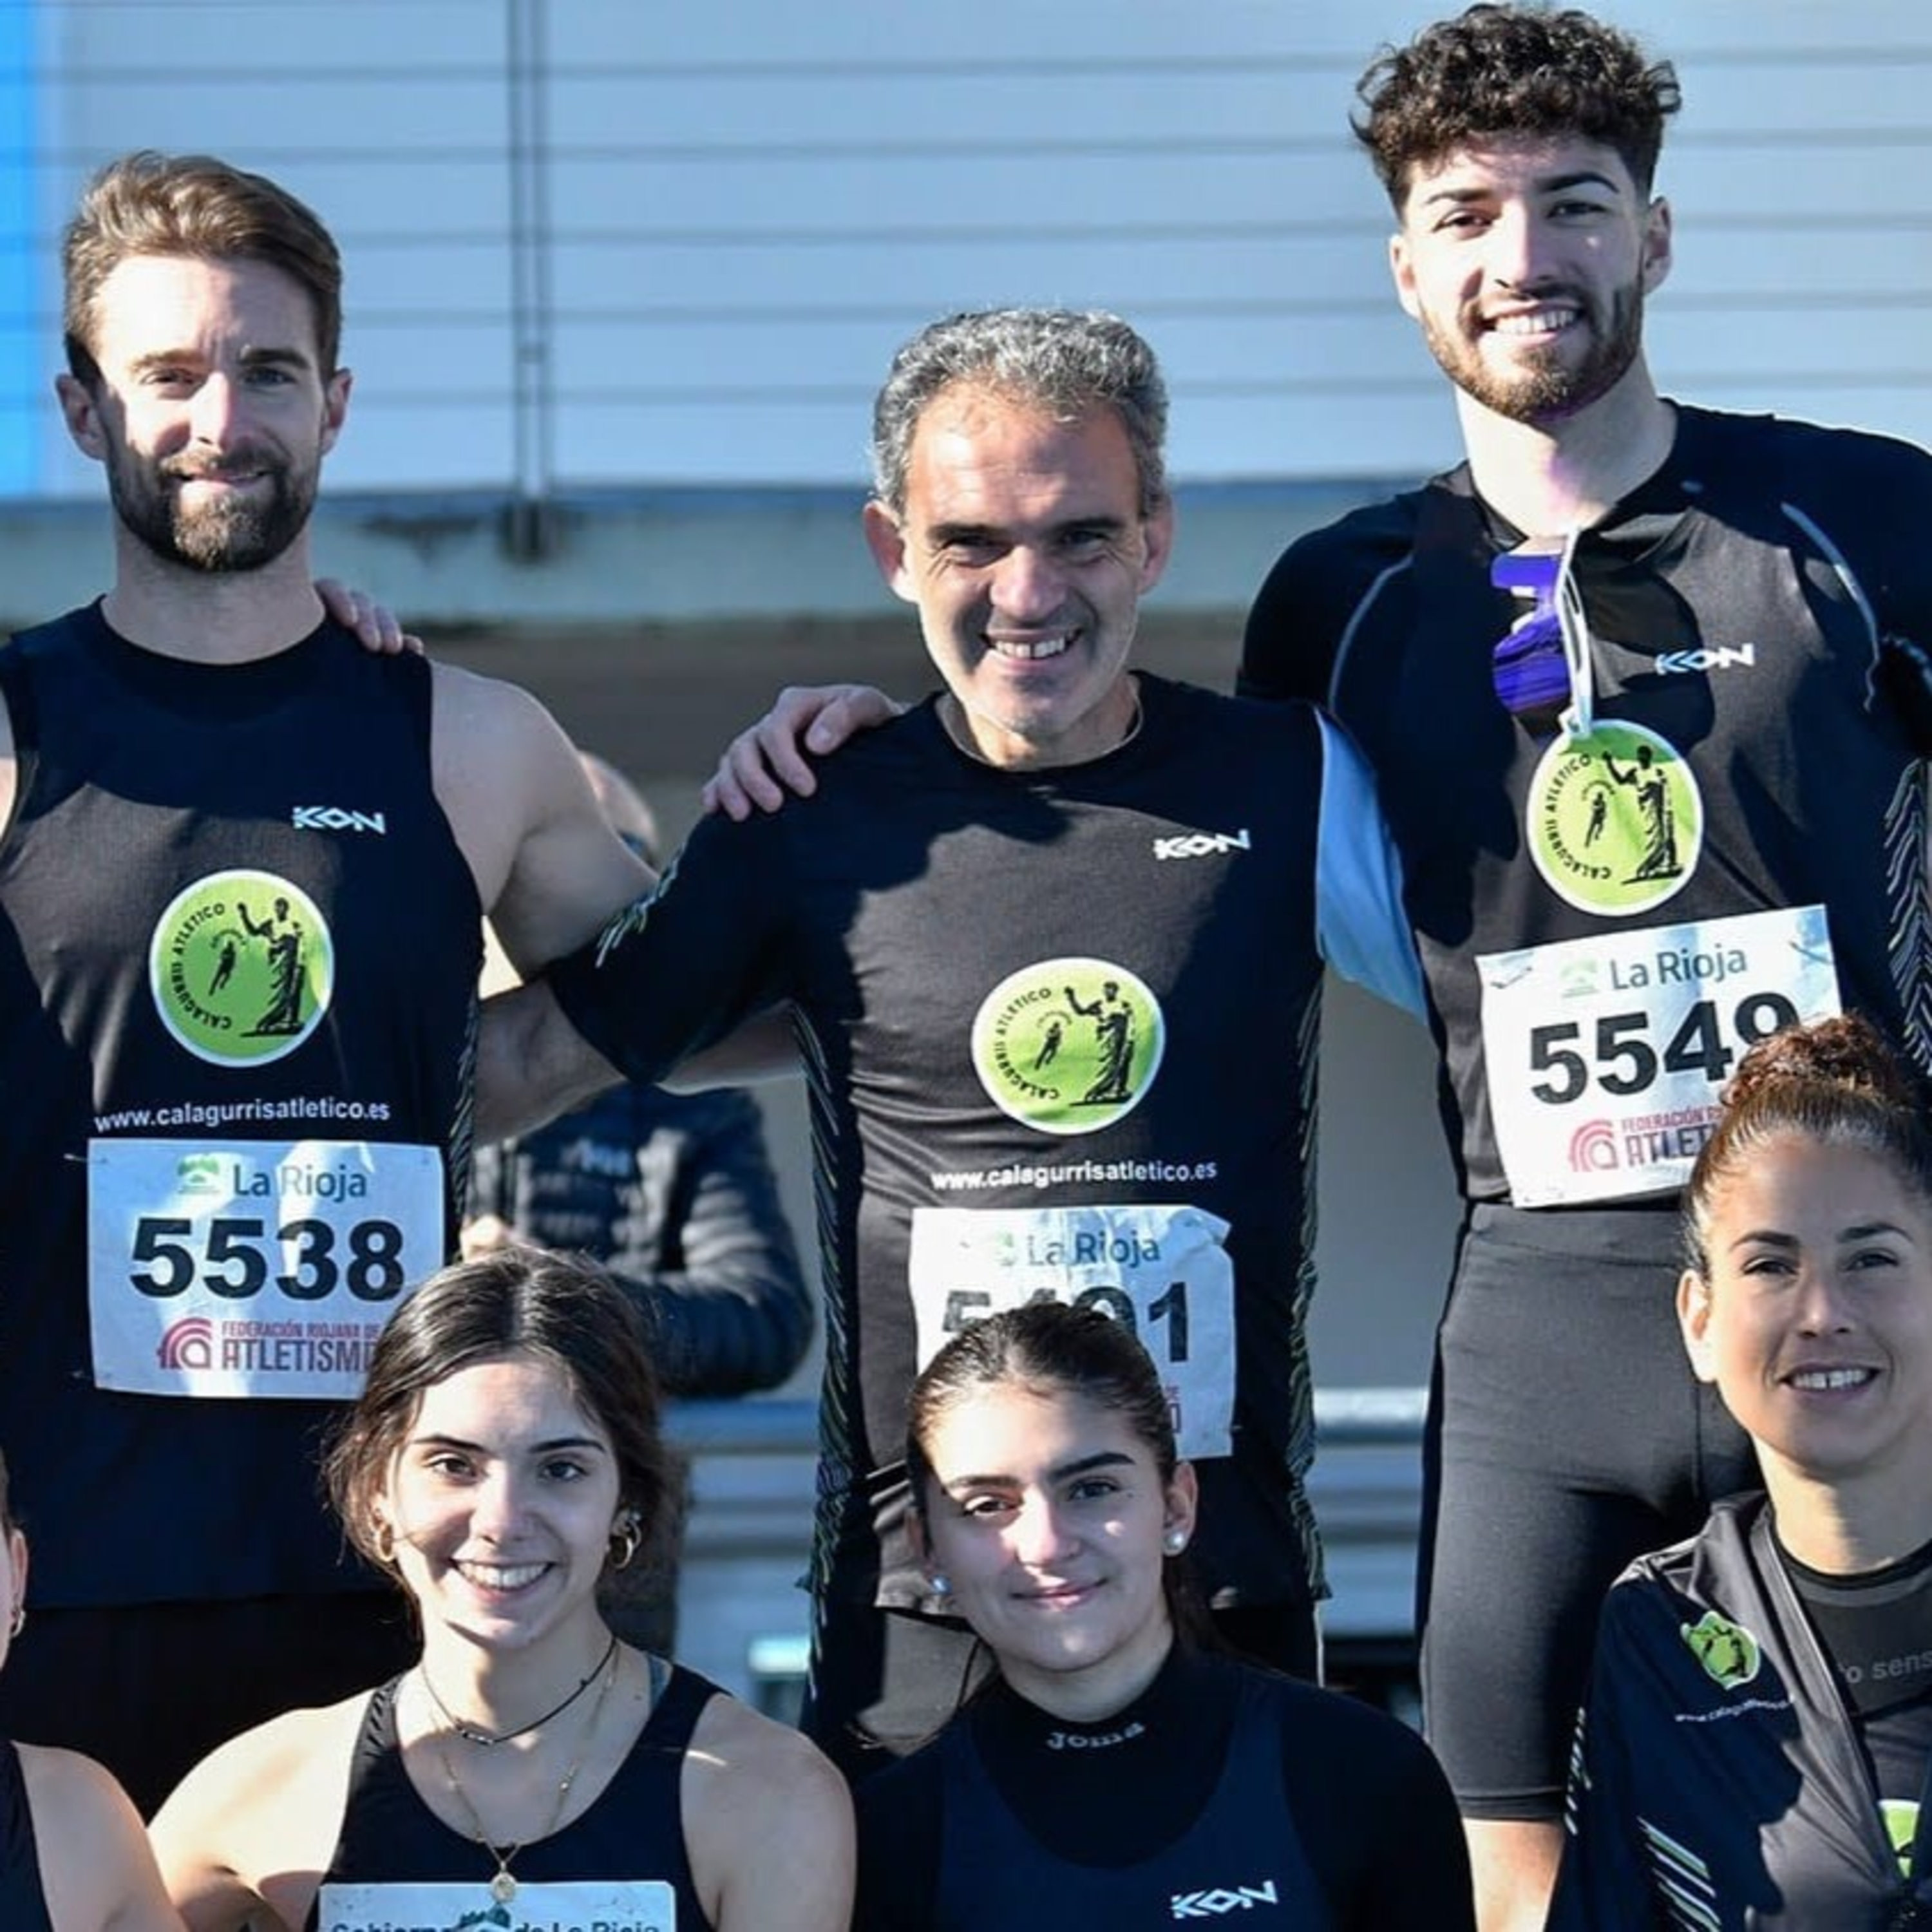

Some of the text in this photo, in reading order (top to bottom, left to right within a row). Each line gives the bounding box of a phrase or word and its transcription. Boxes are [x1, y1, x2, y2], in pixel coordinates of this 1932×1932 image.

[1611, 943, 1747, 990] La Rioja
[94, 1097, 390, 1132] www.calagurrisatletico.es
[233, 1165, 366, 1203] La Rioja
[931, 1160, 1217, 1191] www.calagurrisatletico.es
[129, 1218, 406, 1302] 5538
[1028, 1232, 1160, 1267] La Rioja
[1046, 1721, 1145, 1750] Joma
